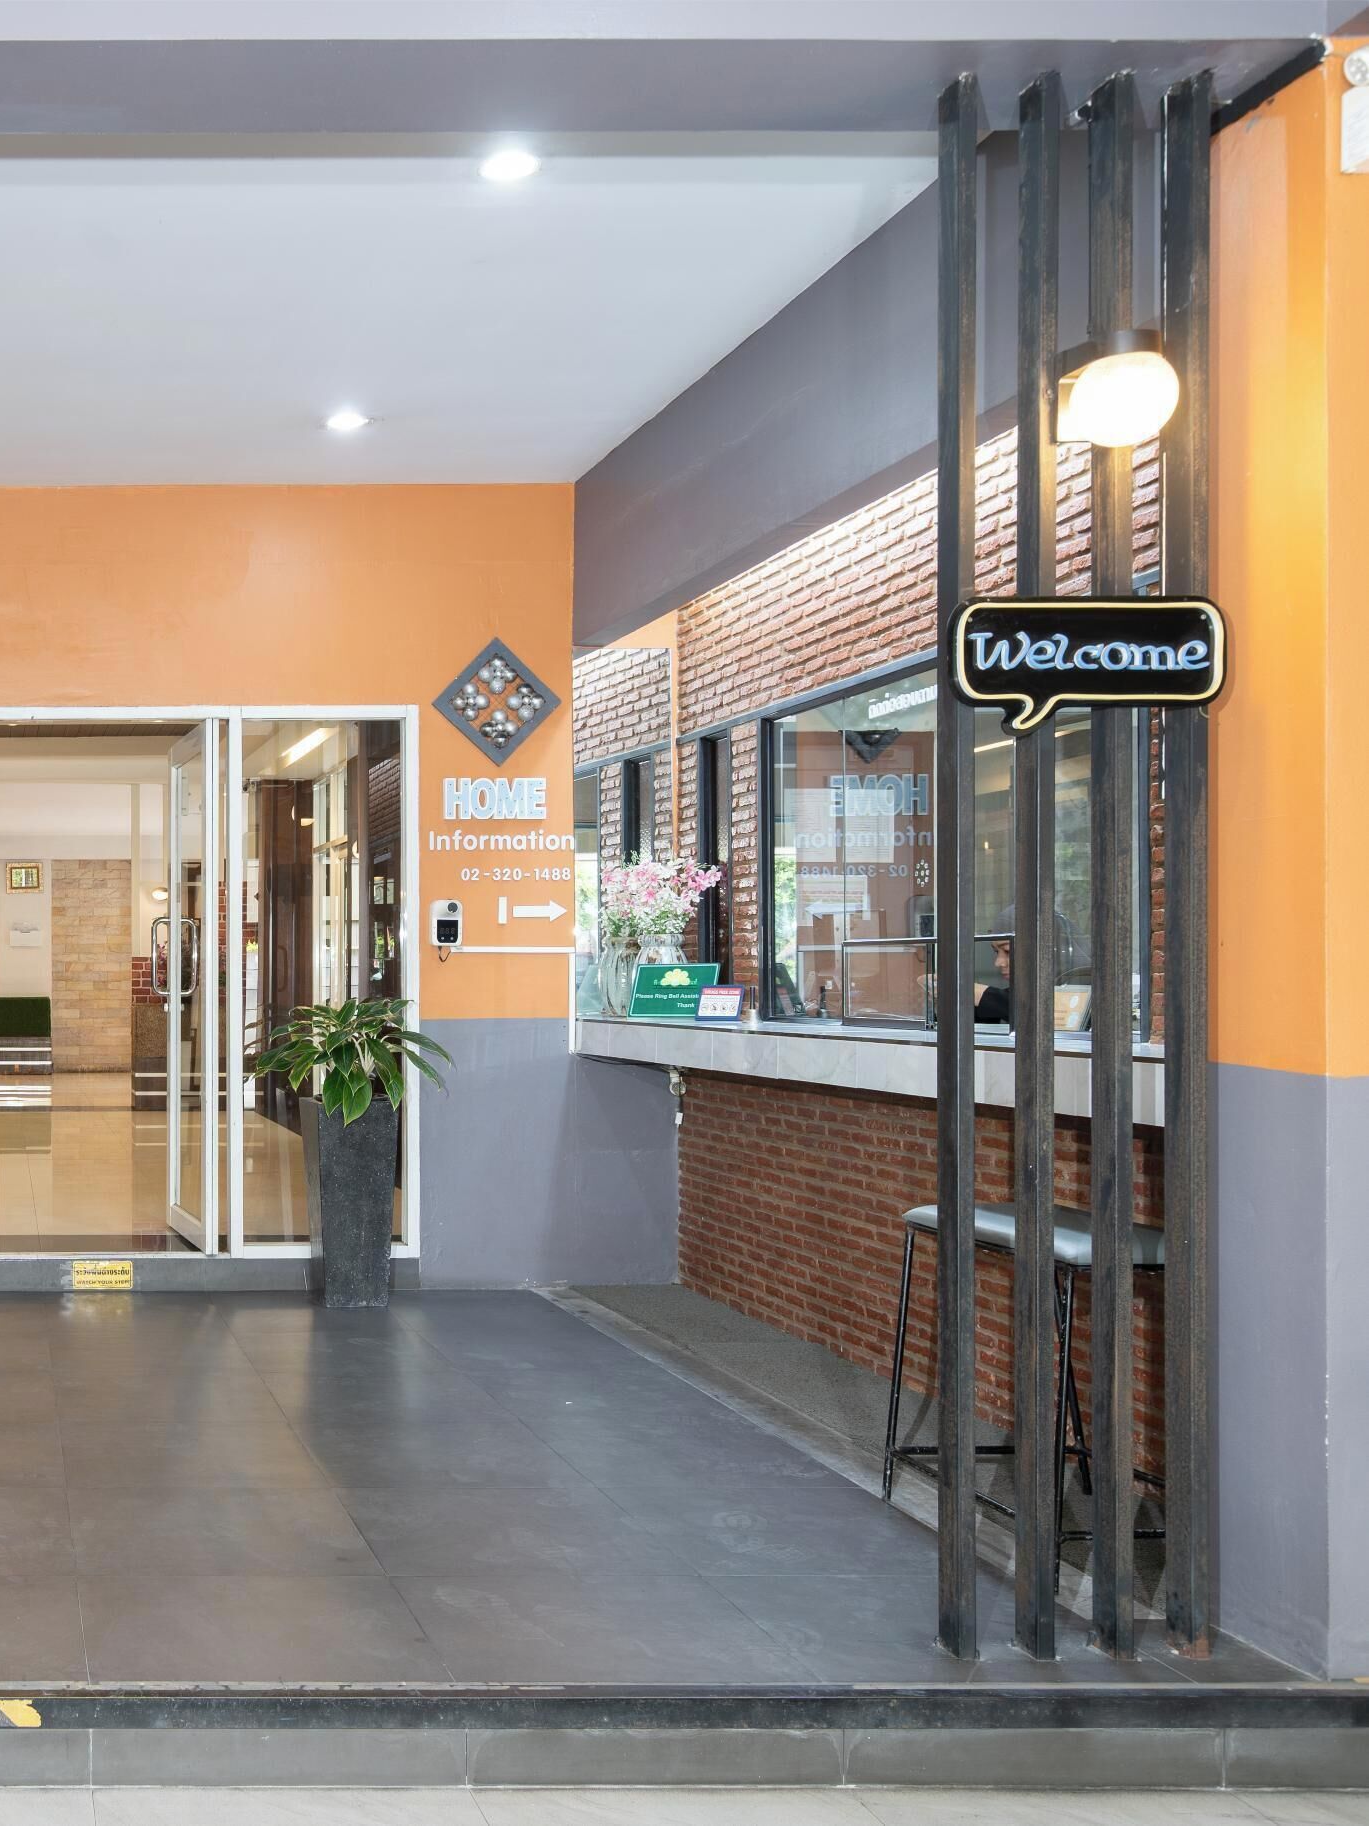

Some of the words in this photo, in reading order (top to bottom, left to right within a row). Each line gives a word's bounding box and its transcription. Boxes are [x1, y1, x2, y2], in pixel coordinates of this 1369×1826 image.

[967, 631, 1210, 671] Welcome
[443, 777, 547, 820] HOME
[429, 829, 575, 851] Information
